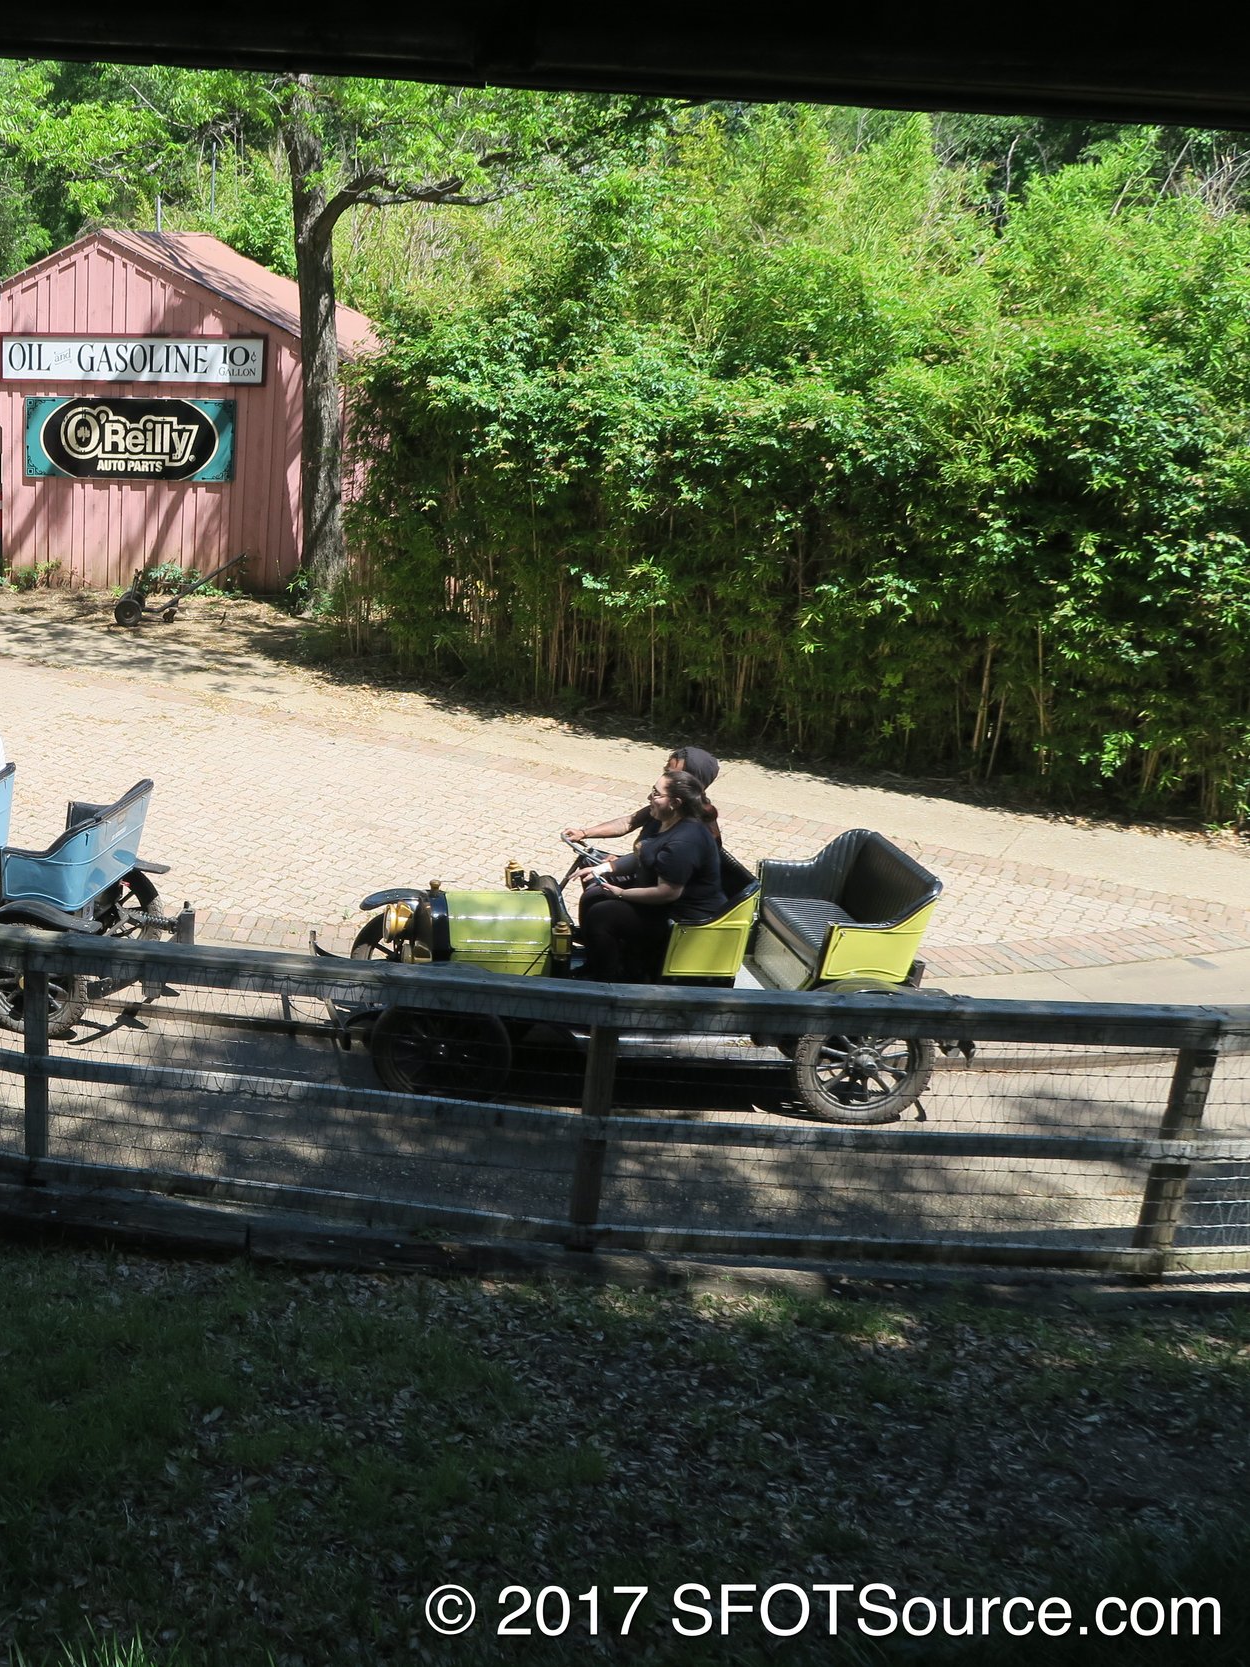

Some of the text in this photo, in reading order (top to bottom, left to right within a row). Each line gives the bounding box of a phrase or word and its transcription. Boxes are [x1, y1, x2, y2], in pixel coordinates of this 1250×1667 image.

[8, 342, 50, 371] OIL
[54, 349, 72, 363] and
[77, 343, 209, 374] GASOLINE
[218, 366, 257, 377] GALLON
[67, 412, 191, 460] O'Reilly
[97, 460, 163, 472] AUTO PARTS
